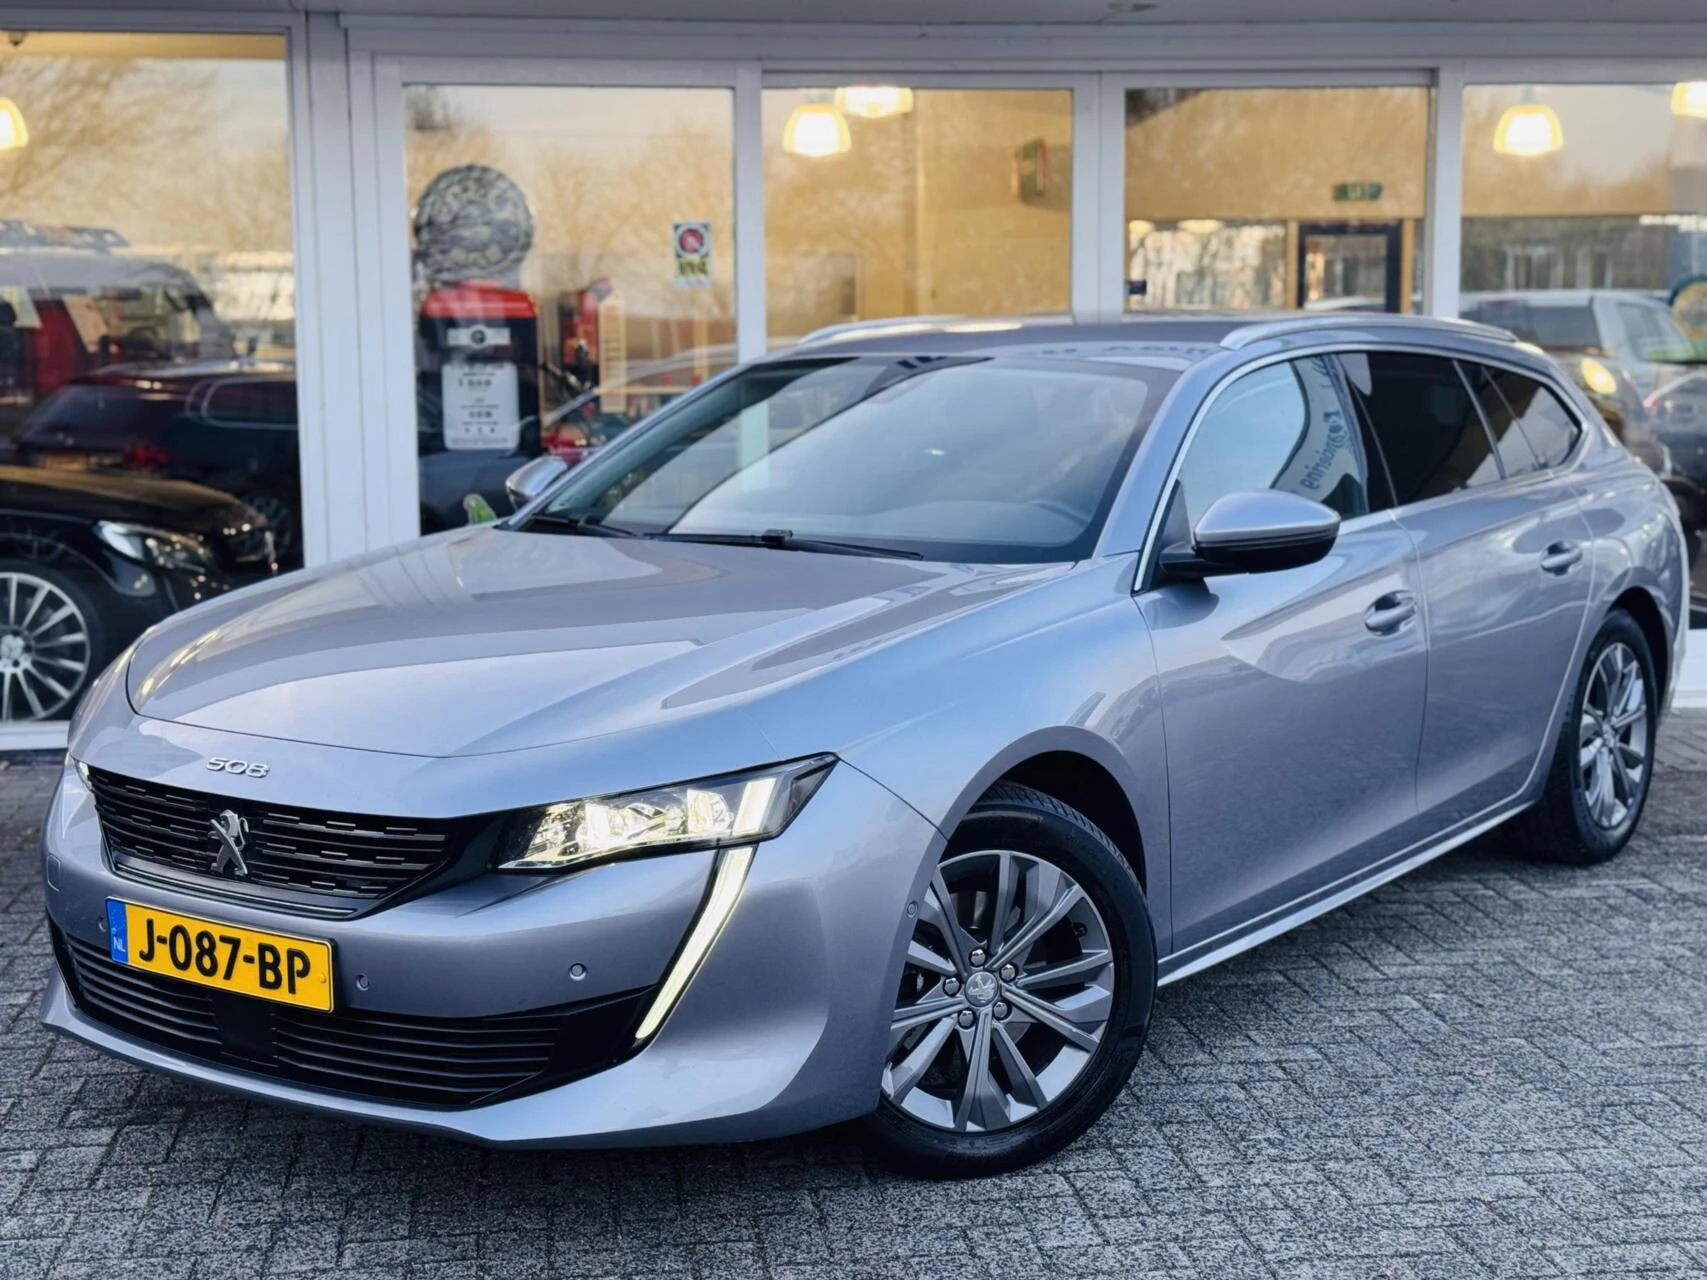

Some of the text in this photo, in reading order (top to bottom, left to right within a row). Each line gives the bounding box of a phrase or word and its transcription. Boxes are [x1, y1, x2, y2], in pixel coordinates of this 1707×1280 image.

[206, 756, 270, 778] 508
[113, 937, 126, 953] NL
[139, 918, 311, 995] J-087-BP
